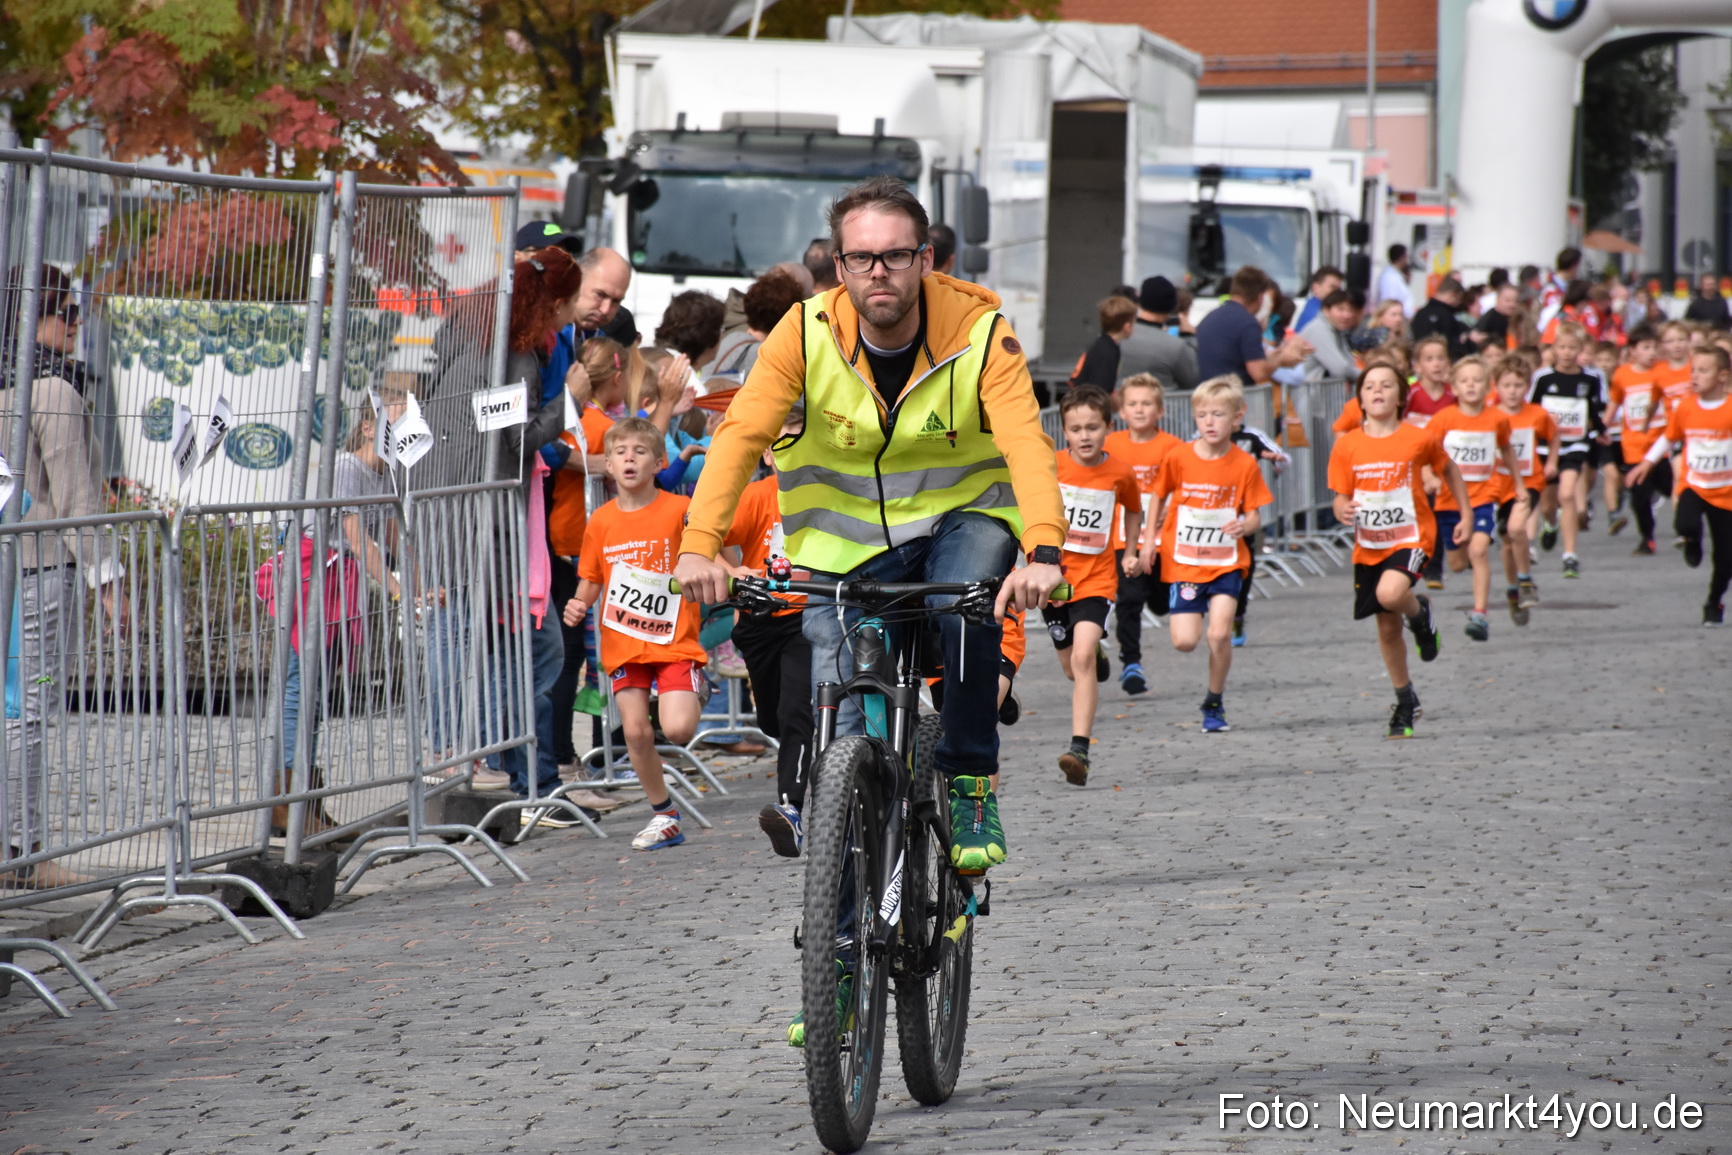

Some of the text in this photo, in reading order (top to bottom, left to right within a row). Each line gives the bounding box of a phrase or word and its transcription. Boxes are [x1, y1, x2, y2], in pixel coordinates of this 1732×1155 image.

[481, 401, 510, 416] swn
[179, 434, 195, 470] swn
[1452, 446, 1486, 462] 7281
[1695, 455, 1728, 470] 7271
[1063, 505, 1102, 529] 152
[1361, 507, 1406, 527] 7232
[1185, 525, 1224, 543] 7777
[603, 540, 647, 554] Neumarkter
[619, 584, 668, 616] 7240
[616, 610, 674, 634] Vincent
